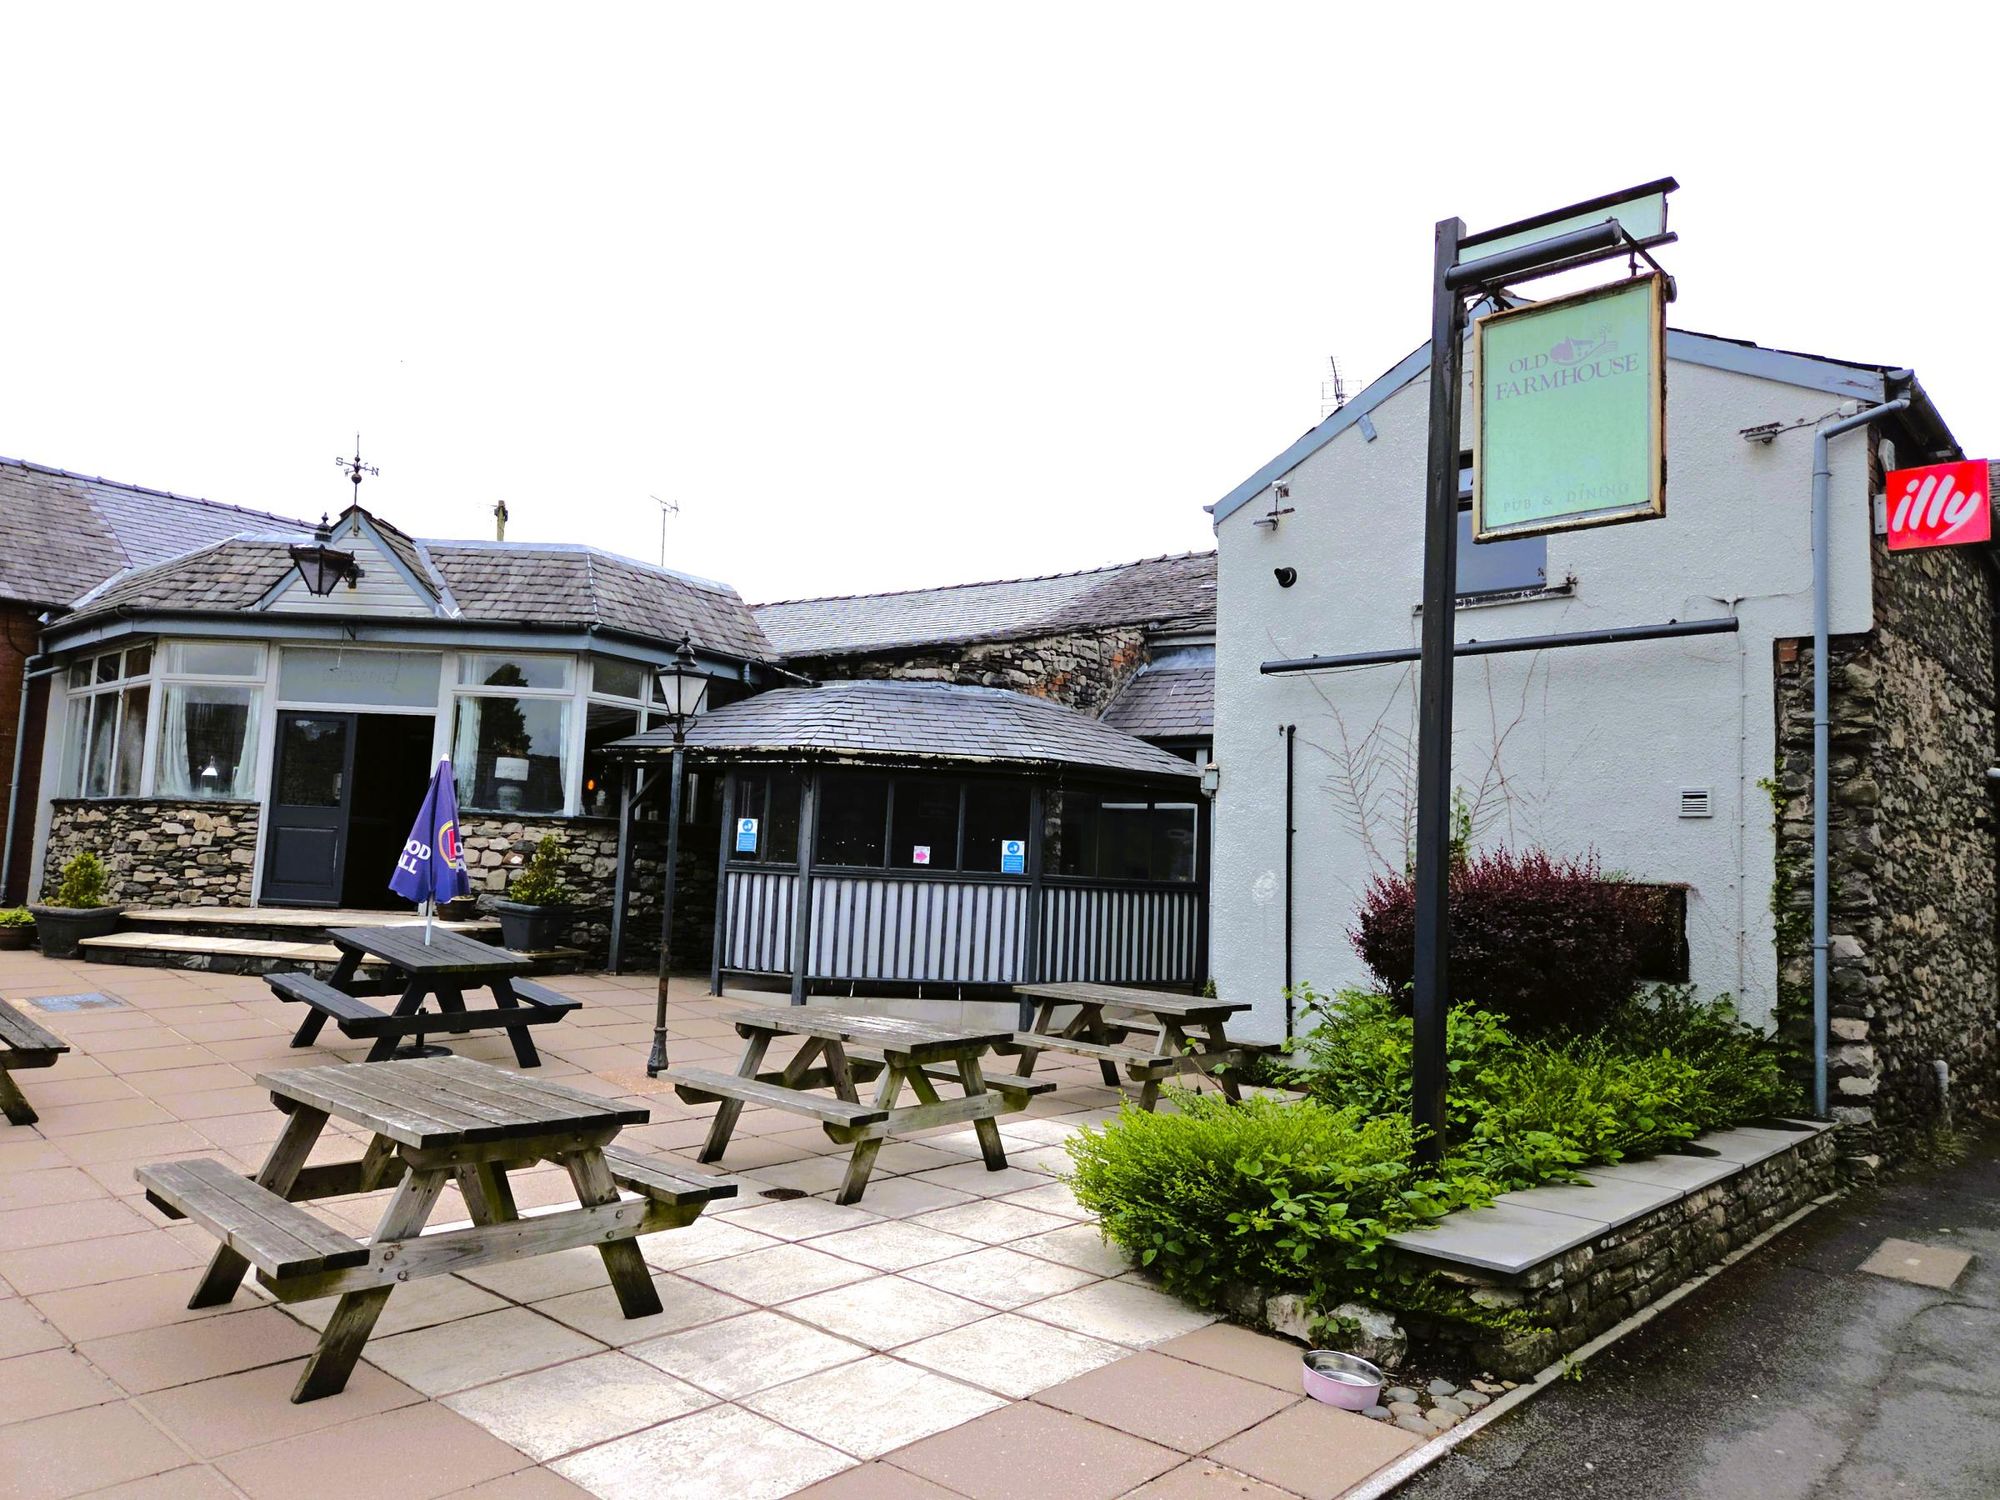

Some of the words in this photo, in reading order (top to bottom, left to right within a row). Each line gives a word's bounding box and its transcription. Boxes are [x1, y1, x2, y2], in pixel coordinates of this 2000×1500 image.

[1496, 353, 1640, 400] FARMHOUSE
[1509, 353, 1548, 374] OLD
[1503, 499, 1532, 512] PUB
[1542, 495, 1552, 505] &
[1892, 474, 1981, 539] illy
